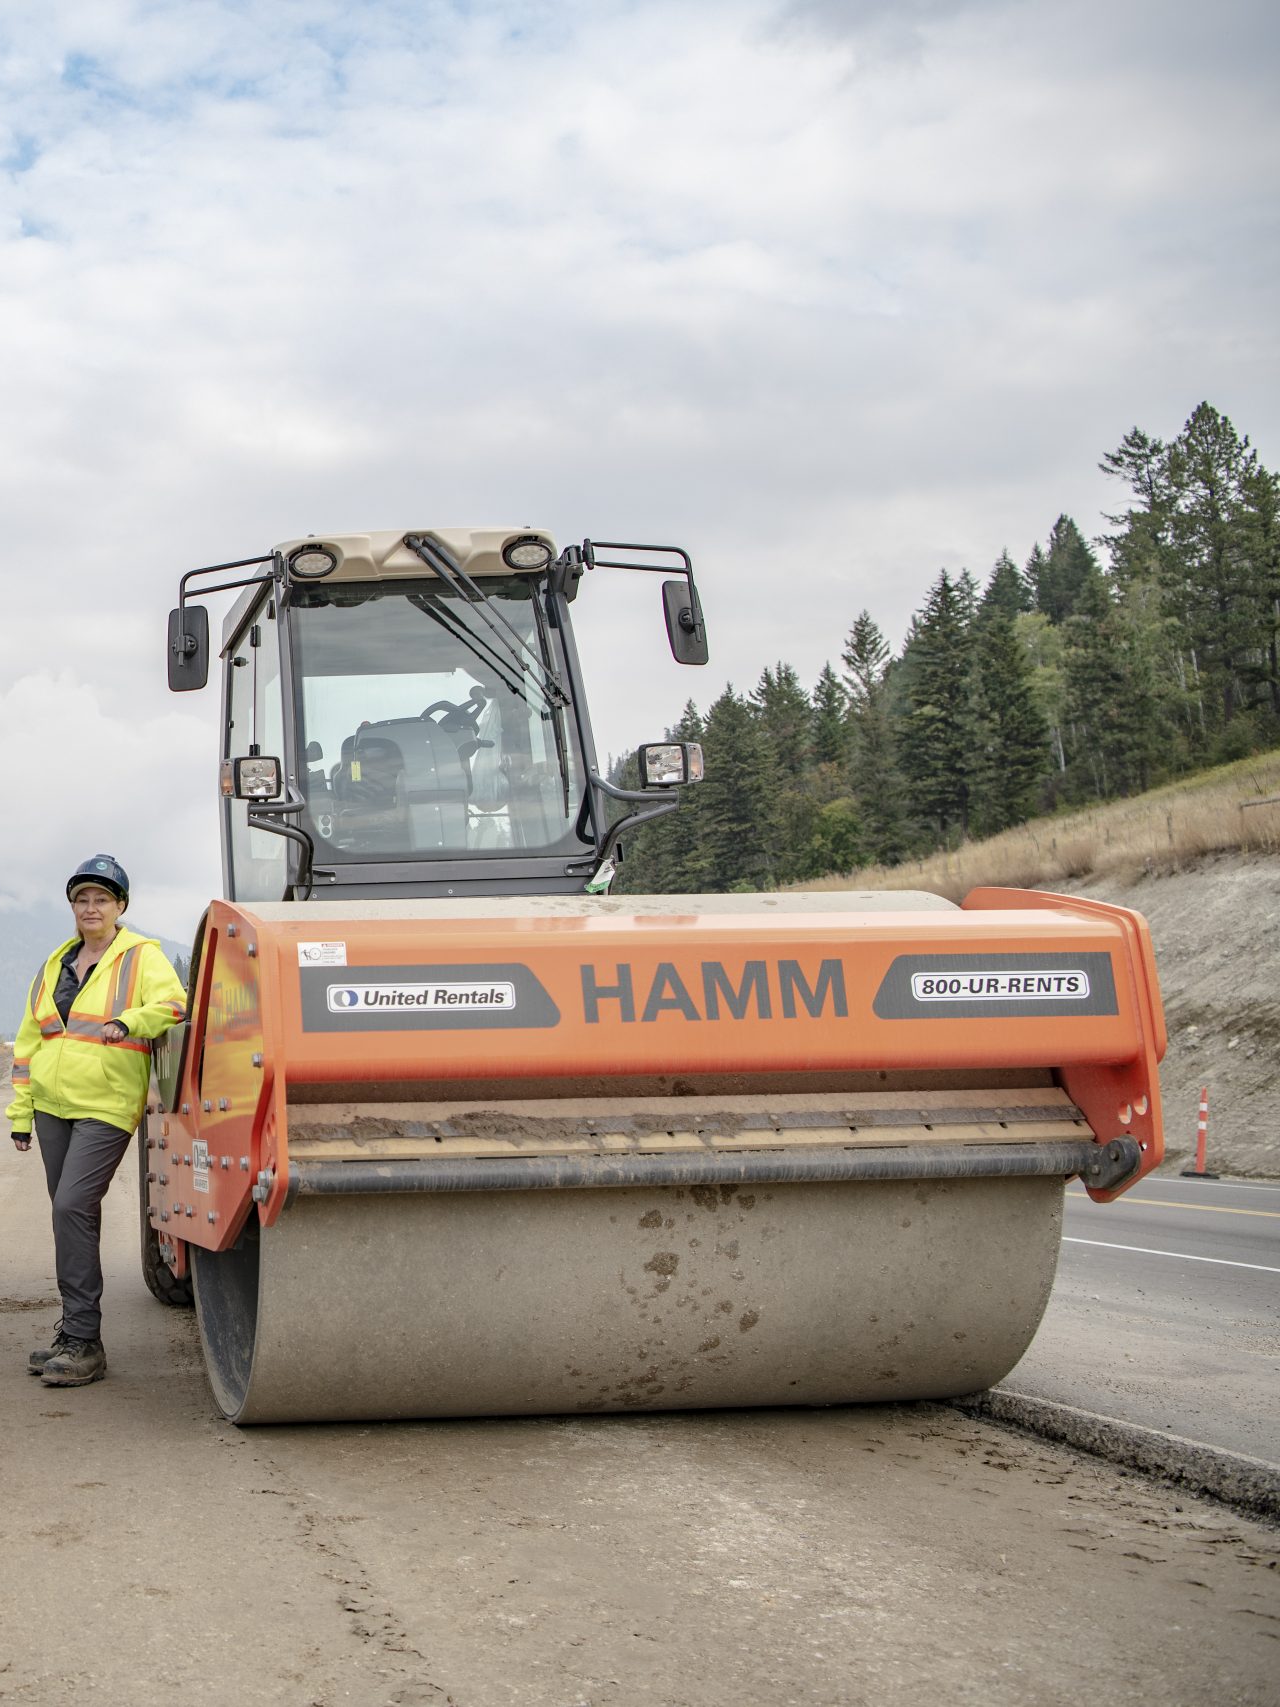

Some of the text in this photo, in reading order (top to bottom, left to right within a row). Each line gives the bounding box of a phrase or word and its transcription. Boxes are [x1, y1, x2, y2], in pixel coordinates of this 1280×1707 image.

[580, 959, 849, 1024] HAMM
[922, 976, 1079, 994] 800-UR-RENTS
[363, 988, 505, 1006] United Rentals
